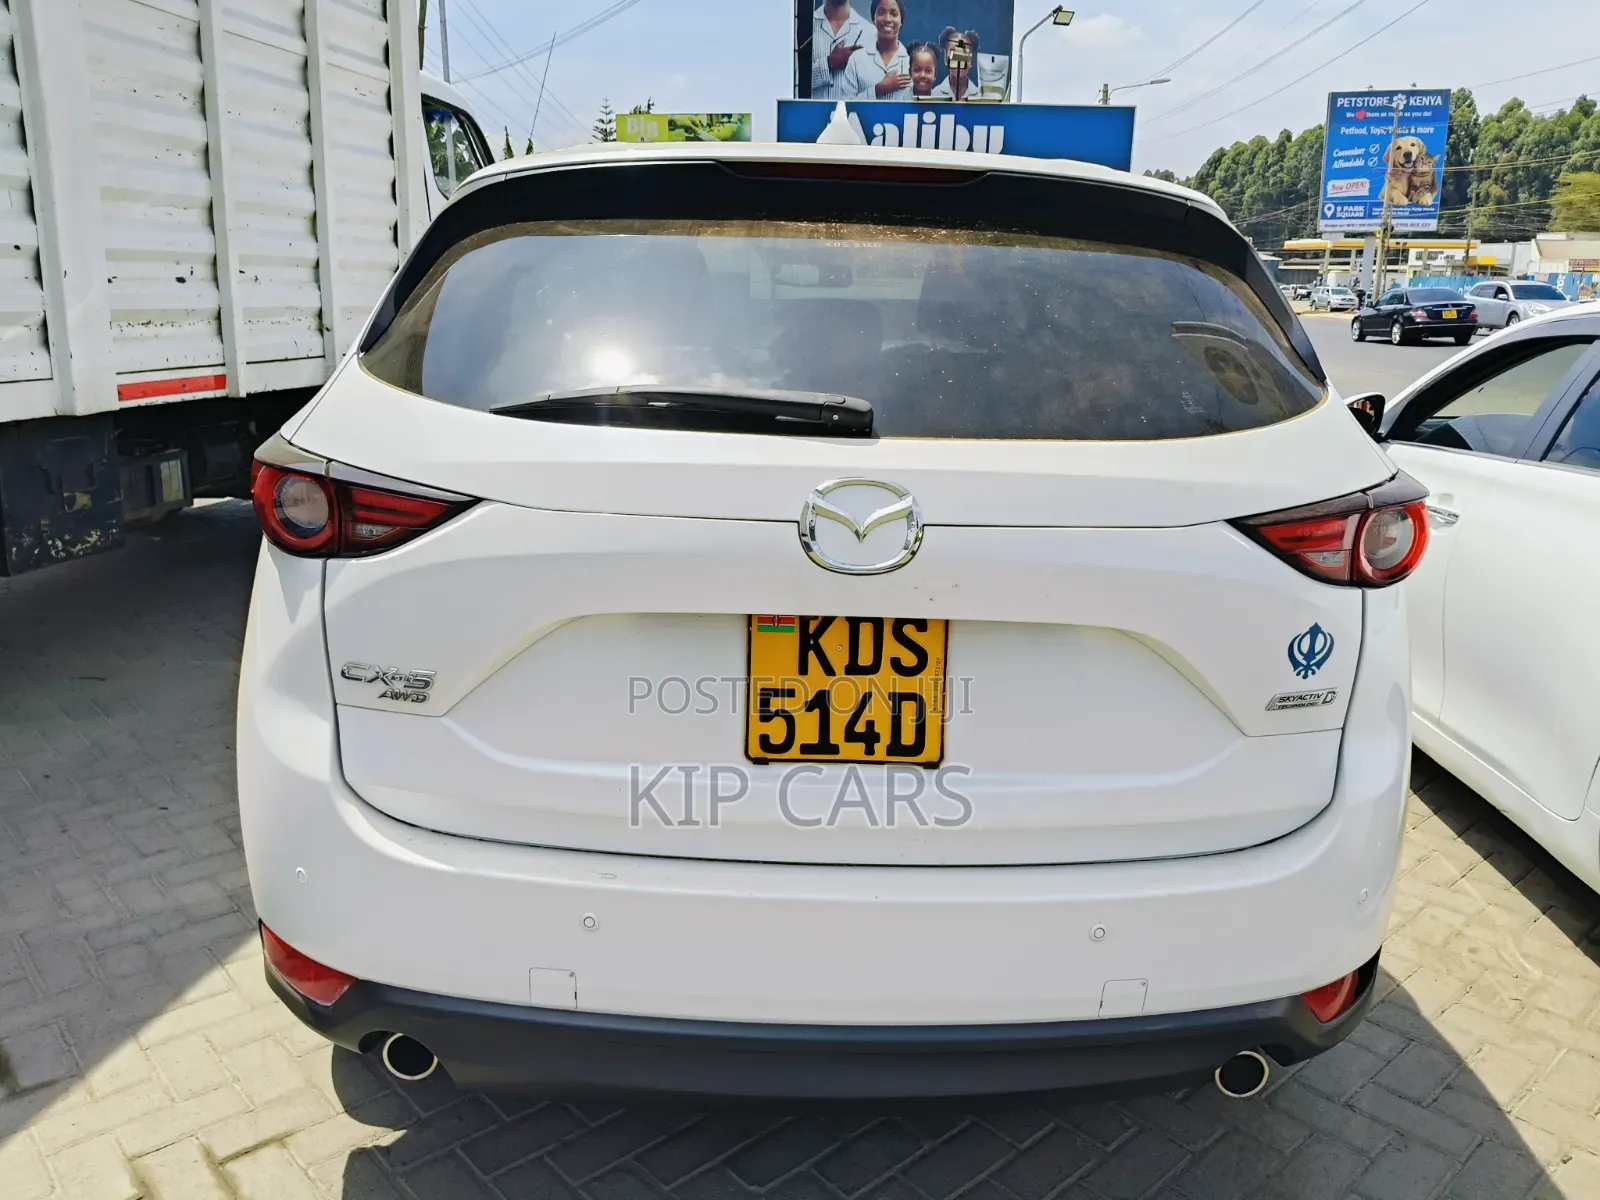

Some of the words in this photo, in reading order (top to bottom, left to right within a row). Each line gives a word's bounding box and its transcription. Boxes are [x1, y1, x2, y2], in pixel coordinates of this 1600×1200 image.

[1337, 97, 1389, 107] PETSTORE
[1409, 95, 1442, 106] KENYA
[1332, 158, 1366, 169] Affordable
[1345, 181, 1368, 189] OPEN!
[798, 615, 929, 677] KDS
[341, 662, 437, 690] CX-5
[378, 688, 430, 703] AWD
[1278, 692, 1324, 703] SKYACTIV
[759, 687, 927, 757] 514D
